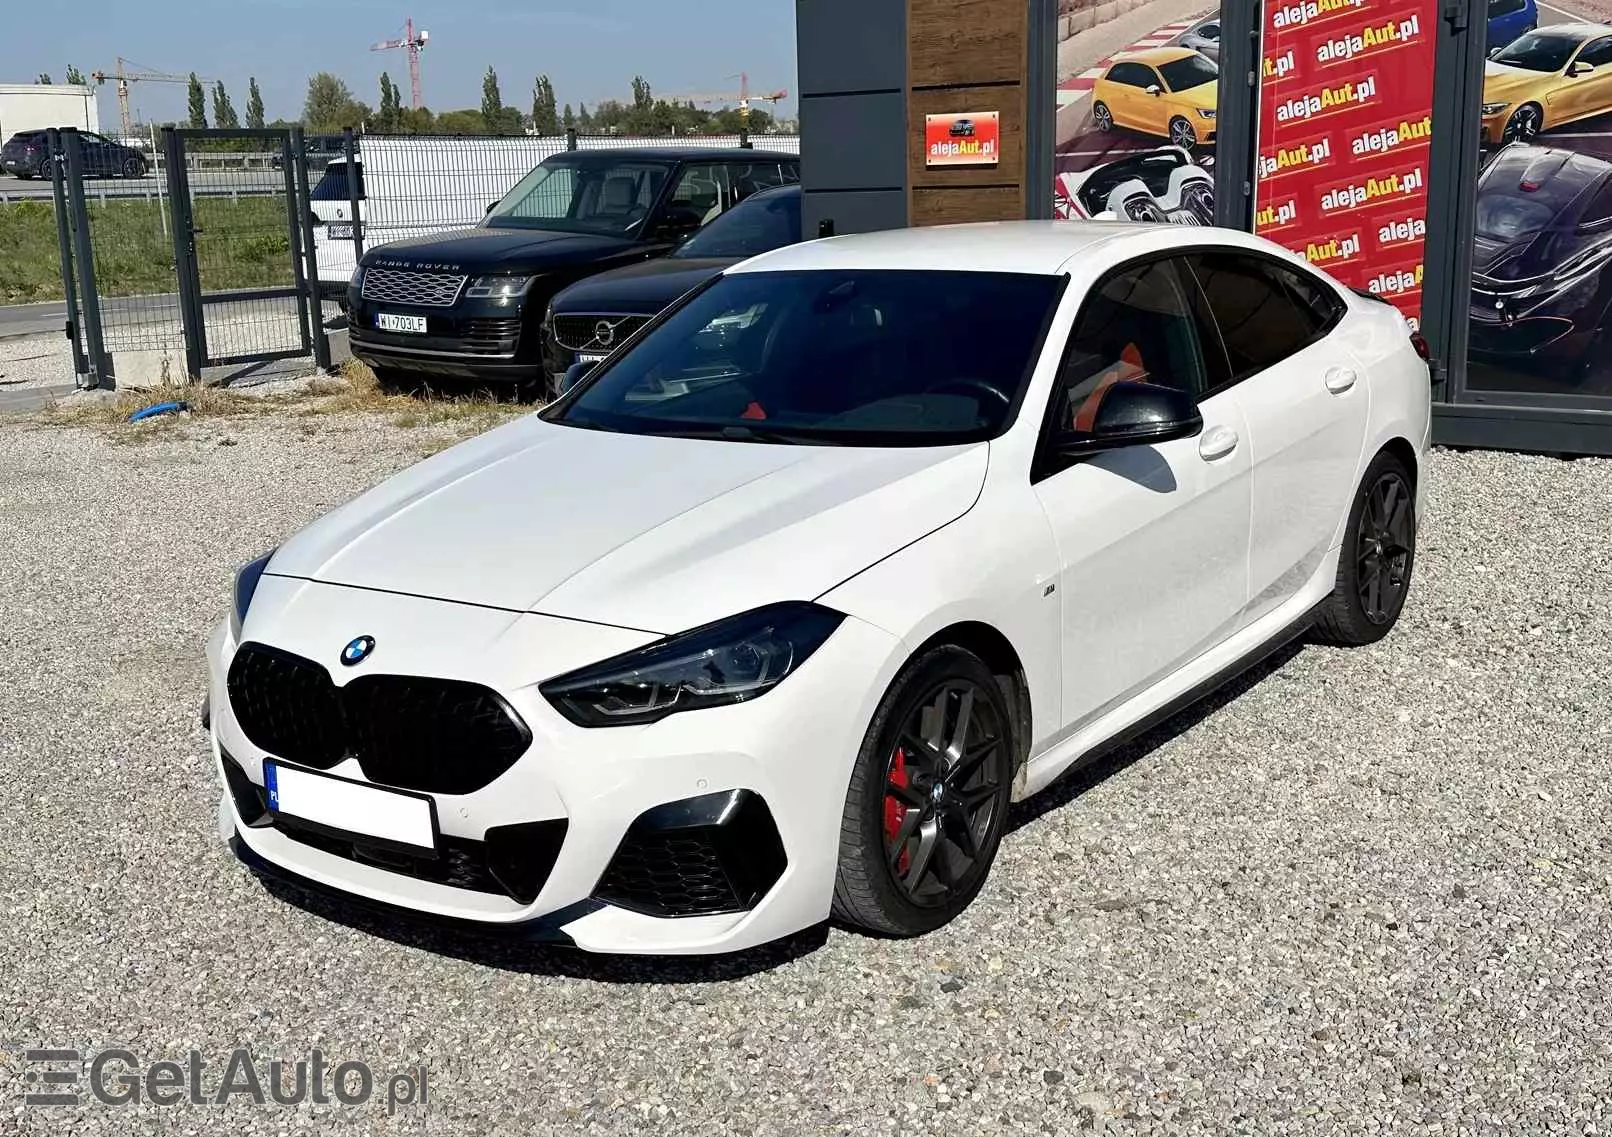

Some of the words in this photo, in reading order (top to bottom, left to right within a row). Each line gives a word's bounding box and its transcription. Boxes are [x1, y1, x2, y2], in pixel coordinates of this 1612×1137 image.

[1273, 0, 1367, 29] alejaAu.
[1316, 14, 1420, 62] alejaAut.pl
[1276, 75, 1377, 122] alejaAut.pl
[930, 139, 995, 158] alejaAut.pl
[1258, 137, 1332, 179] jaAut.pl
[1320, 167, 1423, 211] alejaAut.pl
[1377, 217, 1426, 243] aleja
